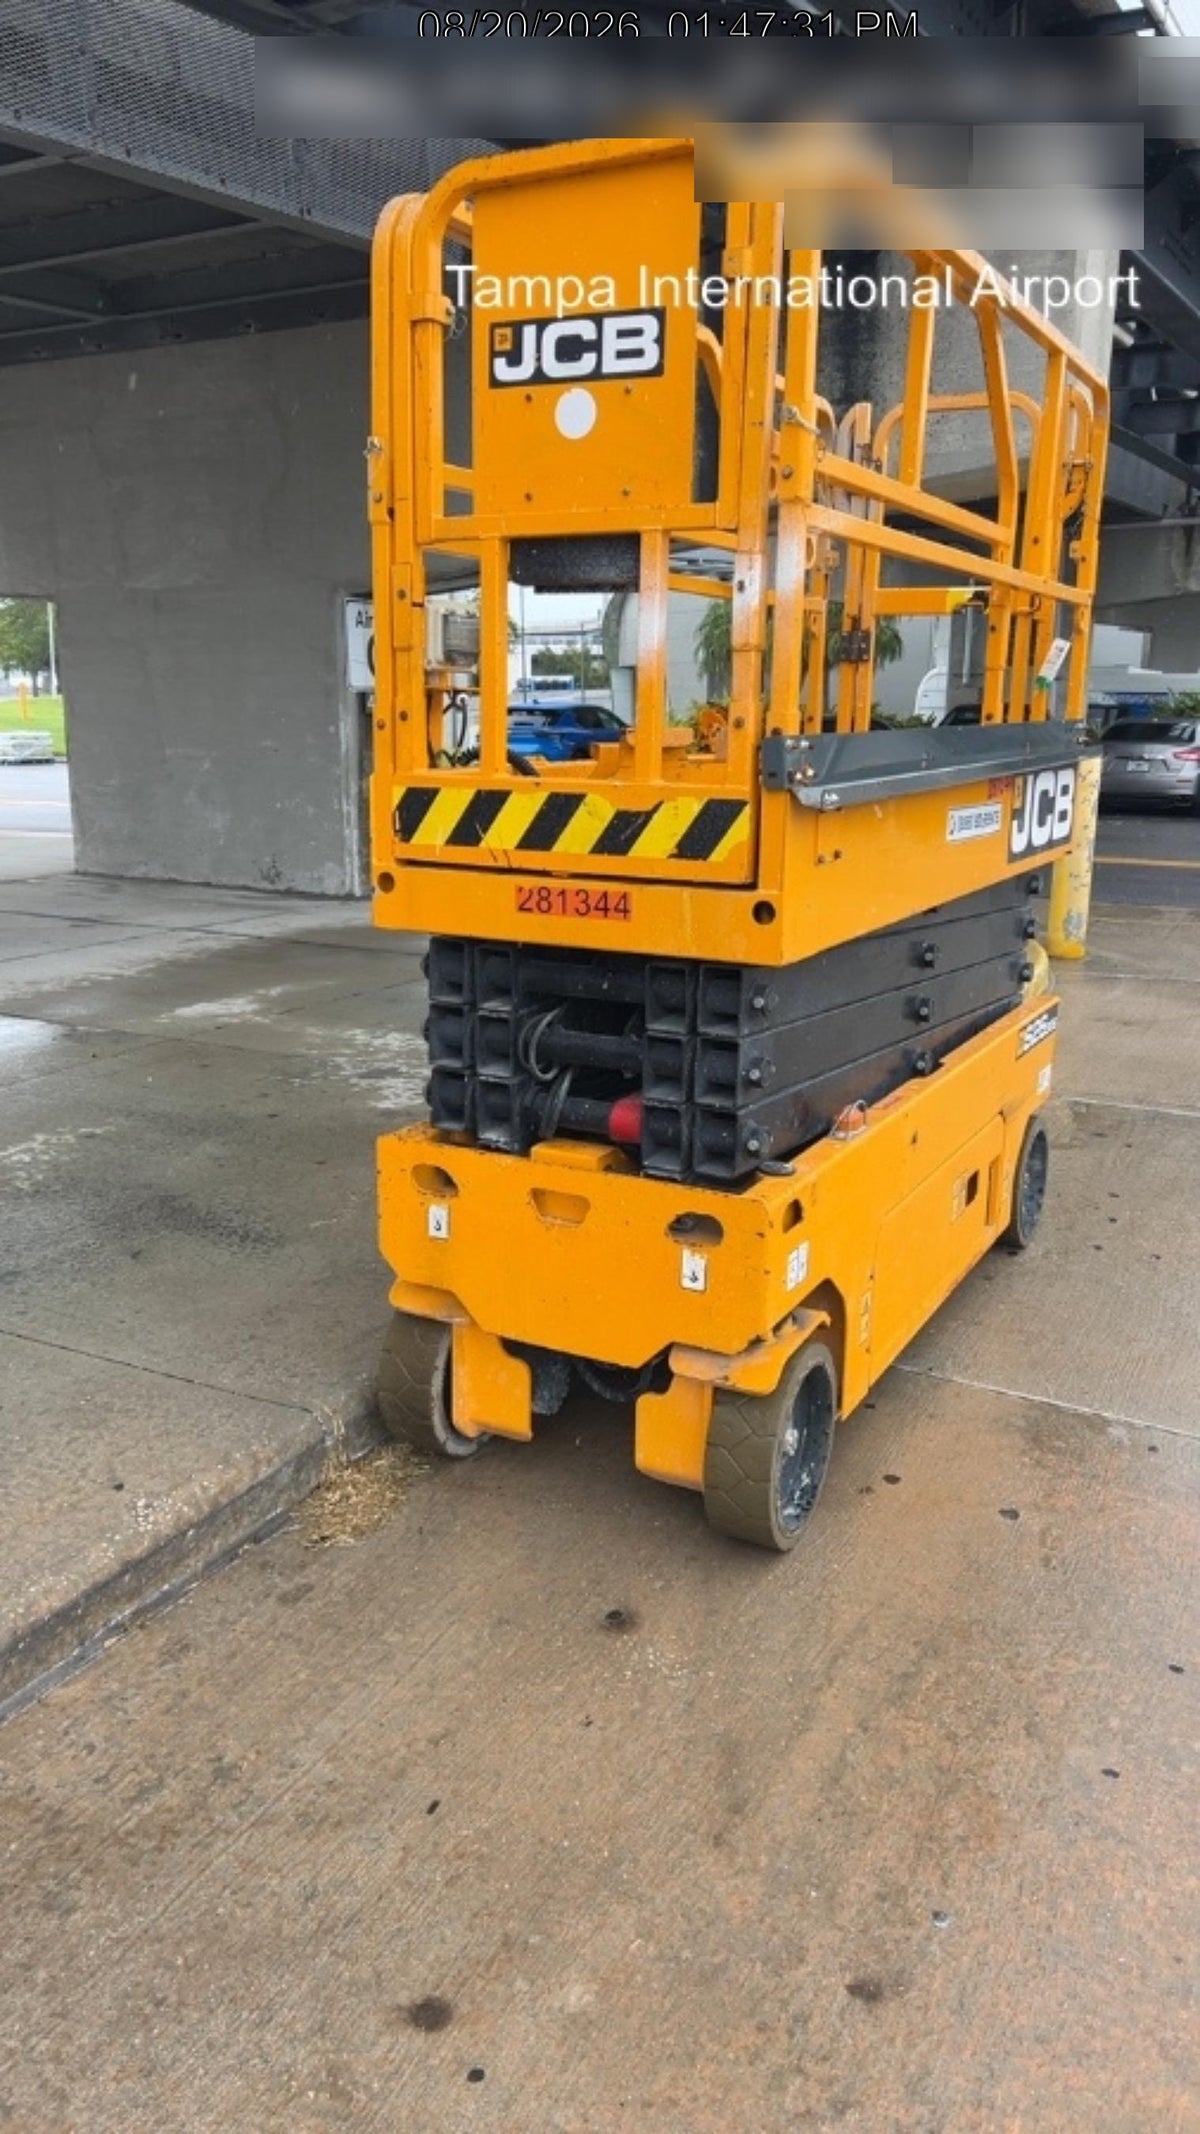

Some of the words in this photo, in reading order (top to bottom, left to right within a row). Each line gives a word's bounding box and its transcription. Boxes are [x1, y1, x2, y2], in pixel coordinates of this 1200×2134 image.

[493, 314, 661, 383] JCB
[1011, 768, 1074, 854] JCB
[518, 886, 631, 919] 281344
